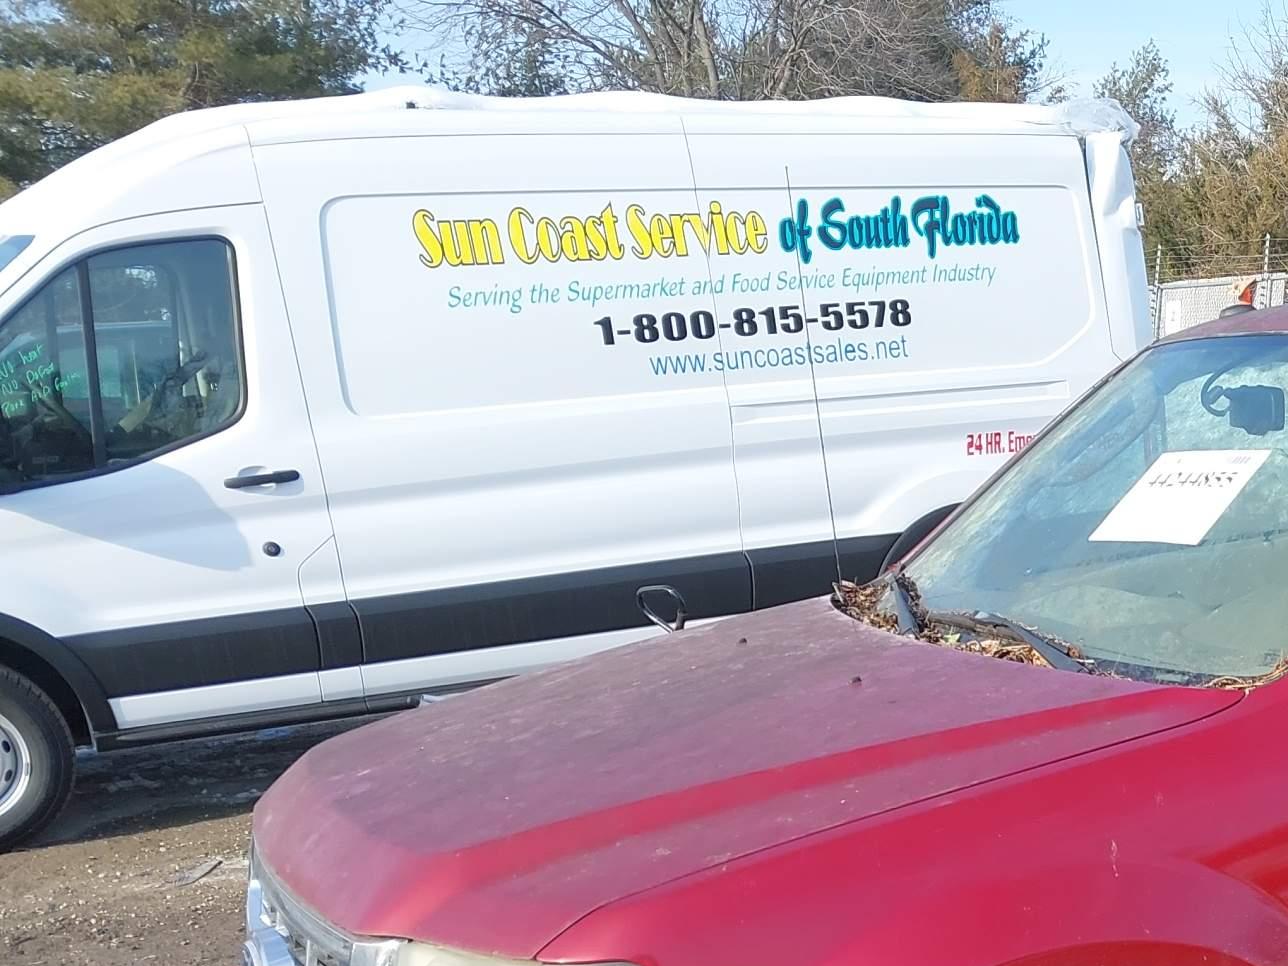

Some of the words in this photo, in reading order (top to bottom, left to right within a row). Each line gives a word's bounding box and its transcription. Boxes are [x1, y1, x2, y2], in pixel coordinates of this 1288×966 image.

[412, 207, 505, 268] Sun
[508, 201, 625, 264] Coast
[626, 200, 769, 258] Service
[779, 198, 813, 264] of
[816, 197, 911, 252] South
[911, 194, 1021, 259] Florida
[447, 284, 523, 314] Serving
[529, 282, 562, 305] the
[567, 276, 686, 306] Supermarket
[691, 274, 725, 296] and
[730, 271, 771, 293] Food
[776, 267, 836, 291] Service
[842, 265, 928, 292] Equipment
[931, 262, 997, 287] Industry
[593, 298, 913, 346] 1-800-815-5578
[649, 335, 910, 376] www.suncoastsales.net
[966, 433, 983, 456] 24
[985, 431, 1005, 454] HR.
[1008, 431, 1036, 453] Eme
